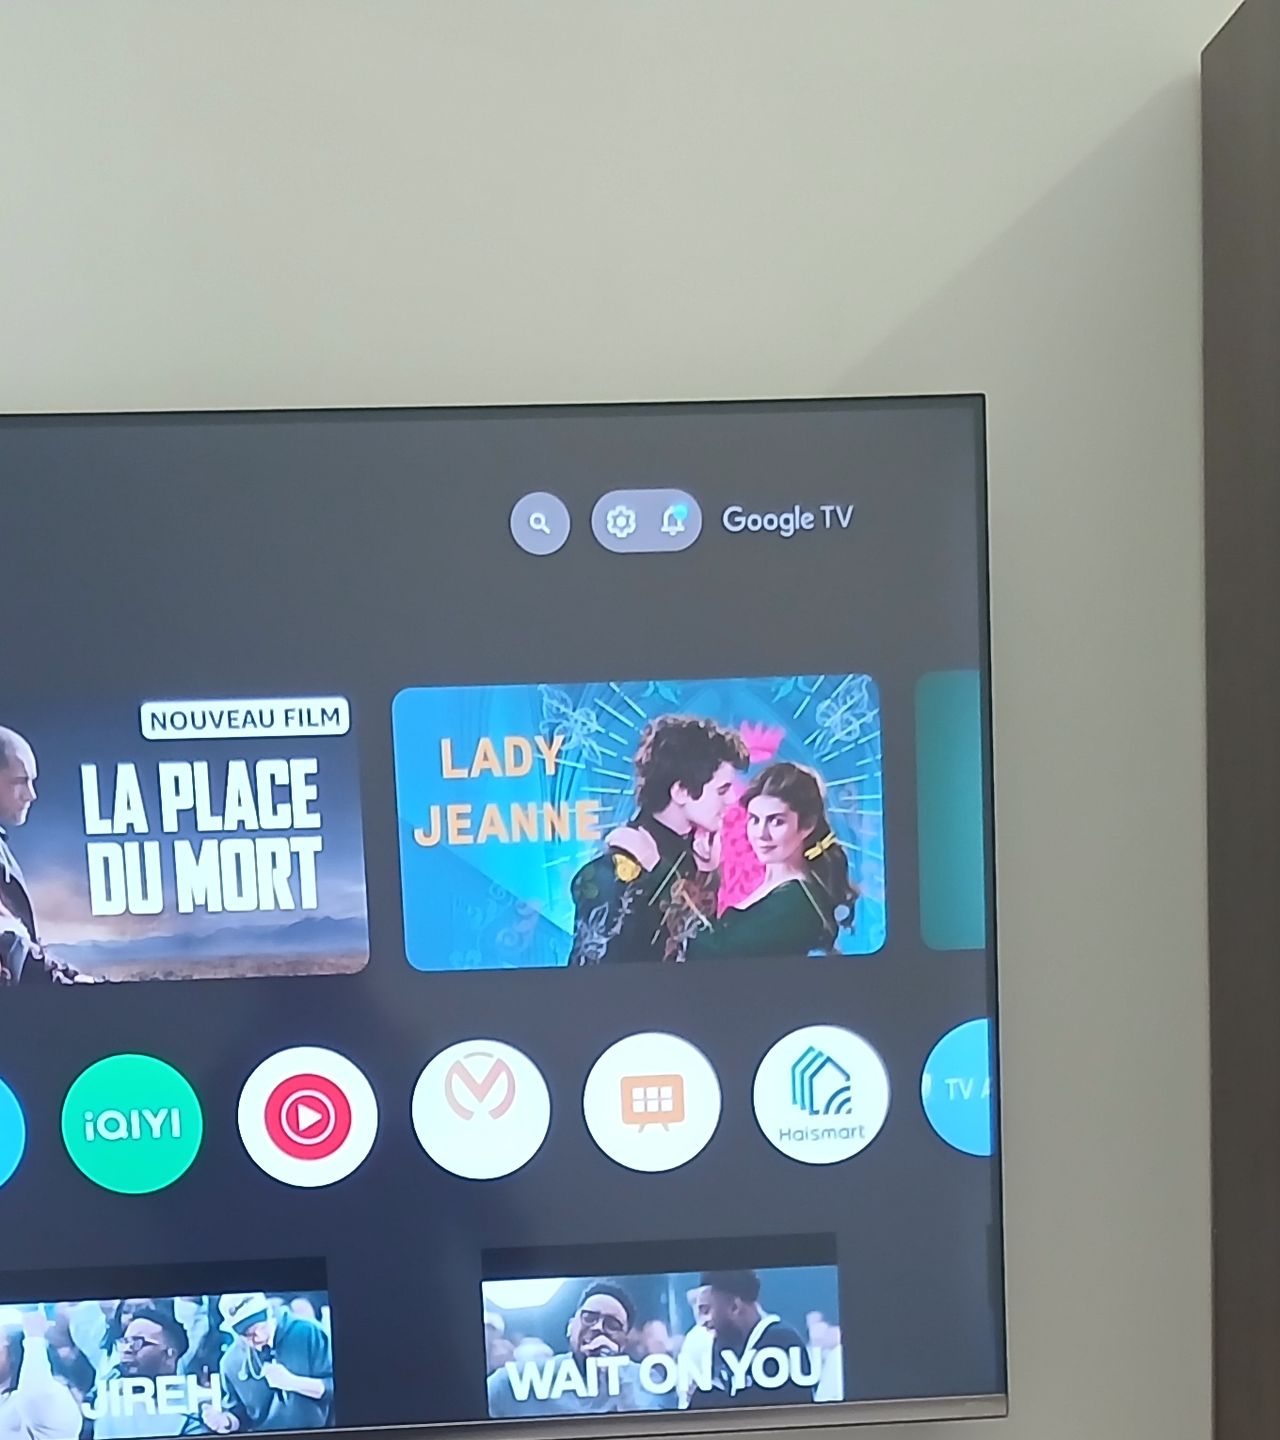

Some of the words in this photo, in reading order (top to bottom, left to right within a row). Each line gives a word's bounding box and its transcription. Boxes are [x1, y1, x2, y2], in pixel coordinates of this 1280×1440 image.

[722, 505, 815, 537] Google
[820, 504, 855, 529] TV
[150, 708, 277, 732] NOUVEAU
[284, 706, 341, 729] FILM
[440, 734, 566, 780] LADY
[80, 762, 149, 835] LA
[158, 758, 321, 834] PLACE
[413, 800, 601, 848] JEANNE
[85, 839, 164, 916] DU
[174, 835, 323, 914] MORT
[944, 1077, 974, 1101] TV
[778, 1124, 866, 1143] Haismart
[505, 1355, 630, 1401] WAIT
[639, 1351, 714, 1395] ON
[720, 1345, 822, 1397] YOU
[81, 1373, 222, 1421] JIREH
